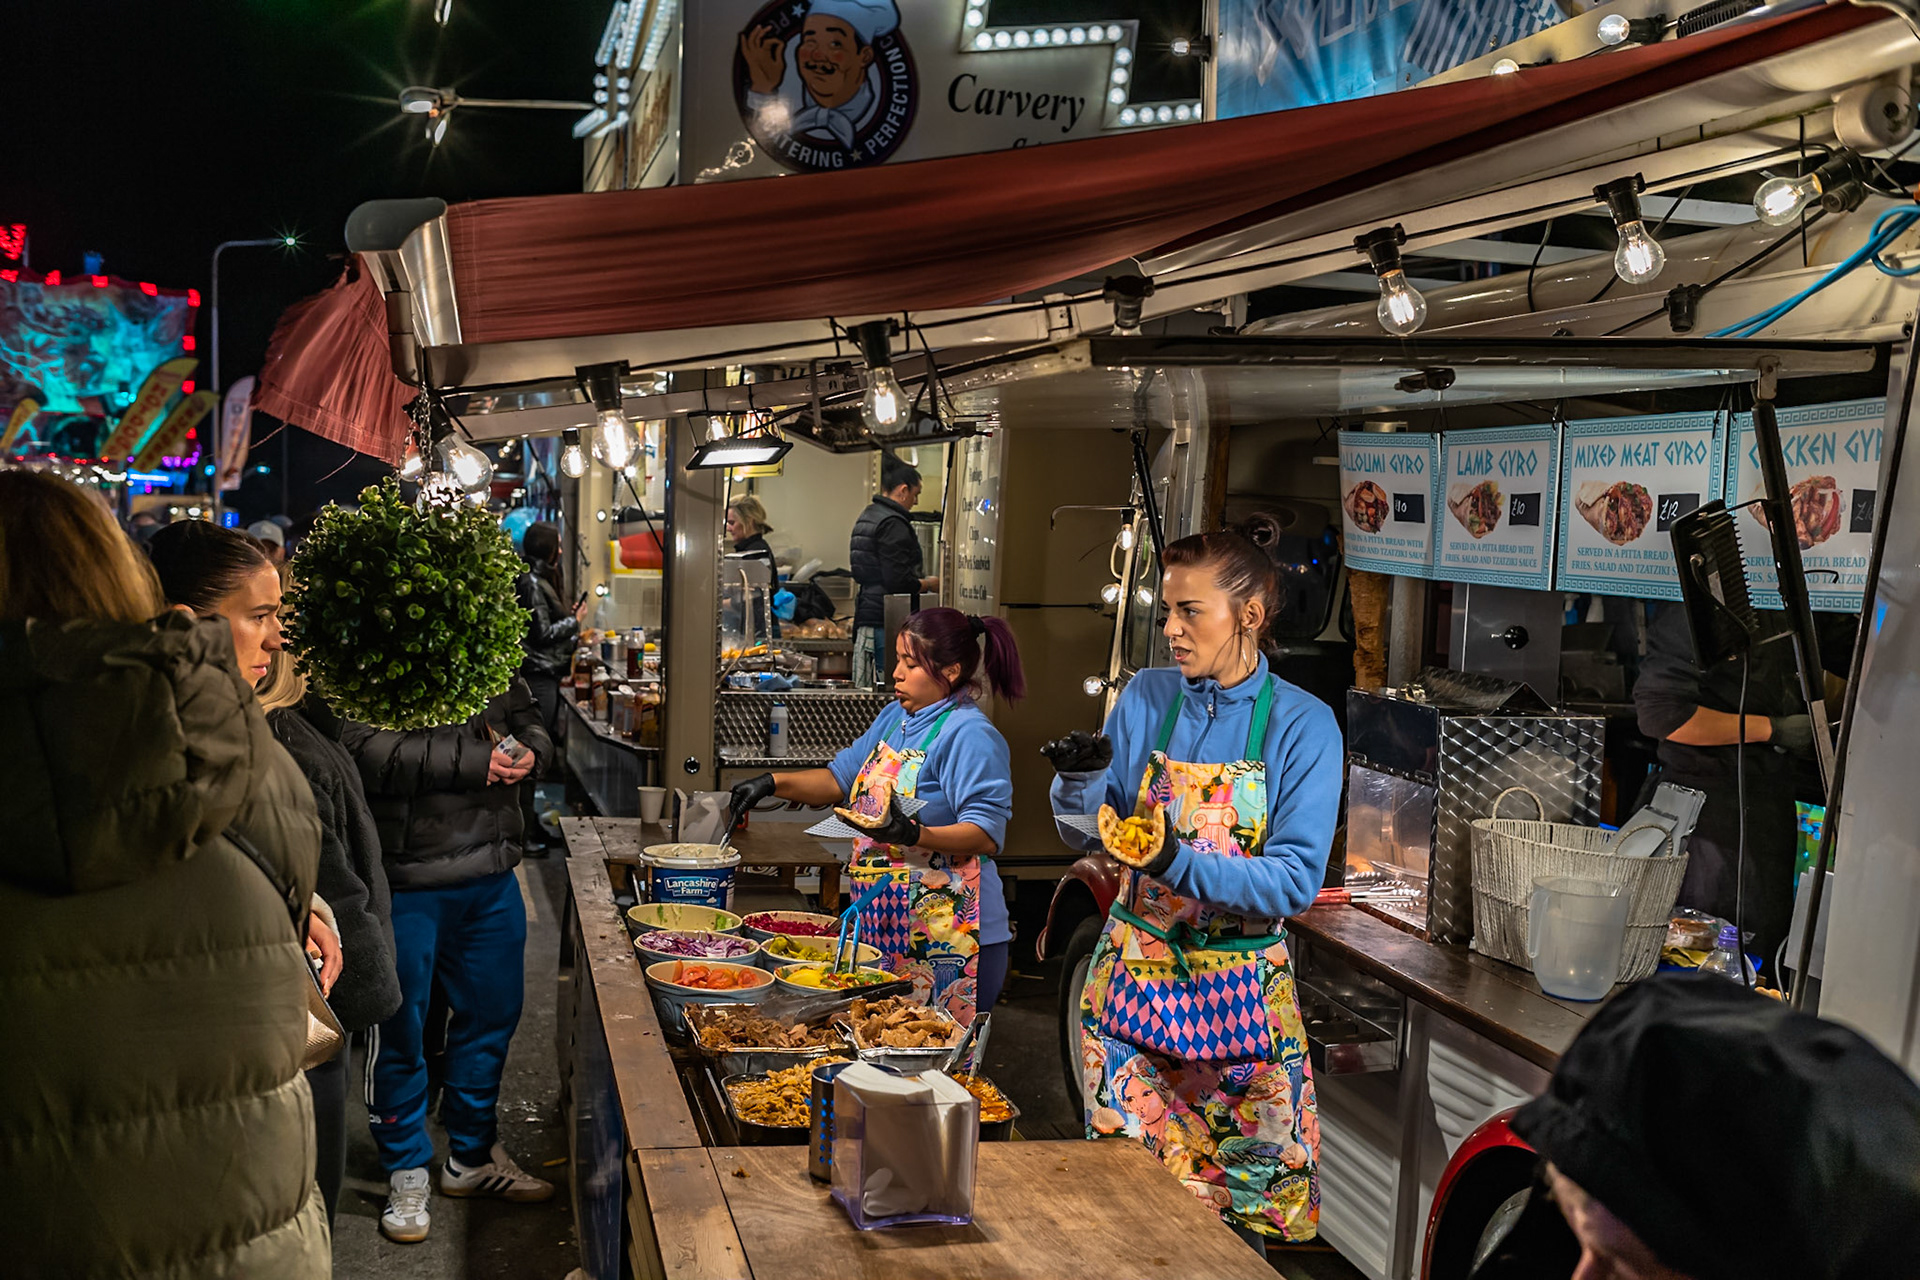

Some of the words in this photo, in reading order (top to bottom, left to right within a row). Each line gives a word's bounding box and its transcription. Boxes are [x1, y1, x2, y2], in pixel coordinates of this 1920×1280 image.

[865, 47, 909, 155] PERFECTION
[947, 73, 1086, 133] Carvery
[773, 133, 844, 168] TERING
[1574, 444, 1617, 468] MIXED
[1620, 442, 1660, 467] MEAT
[1664, 439, 1708, 466] GYRO
[1748, 431, 1836, 470] CCKEN
[1341, 452, 1386, 473] ALLOUMI
[1389, 453, 1425, 475] GYRO
[1457, 448, 1494, 476] LAMB
[1498, 448, 1538, 477] GYRO
[1511, 498, 1526, 517] £10
[1659, 498, 1680, 521] £12
[1449, 542, 1469, 551] SERVED
[1498, 544, 1517, 554] BREAD
[1518, 545, 1535, 555] WITH
[1577, 547, 1603, 557] SERVED
[1604, 548, 1613, 558] IN
[1614, 549, 1619, 558] A
[1621, 549, 1642, 559] PITTA
[1643, 550, 1669, 560] BREAD
[1461, 554, 1479, 564] SALAD
[1480, 555, 1491, 565] AND
[1492, 557, 1518, 567] TZATZIKI
[1518, 559, 1538, 568] SAUCE
[1571, 560, 1593, 571] FRIES,
[1594, 561, 1617, 572] SALAD
[1617, 563, 1634, 573] AND
[1636, 564, 1670, 576] TZATZIKI
[1745, 556, 1776, 567] SERVE
[1803, 556, 1830, 568] PITTA
[1833, 556, 1866, 568] BREAD
[1822, 573, 1868, 584] TZTZIK
[666, 878, 717, 889] Lancashire
[681, 887, 703, 895] Farm
